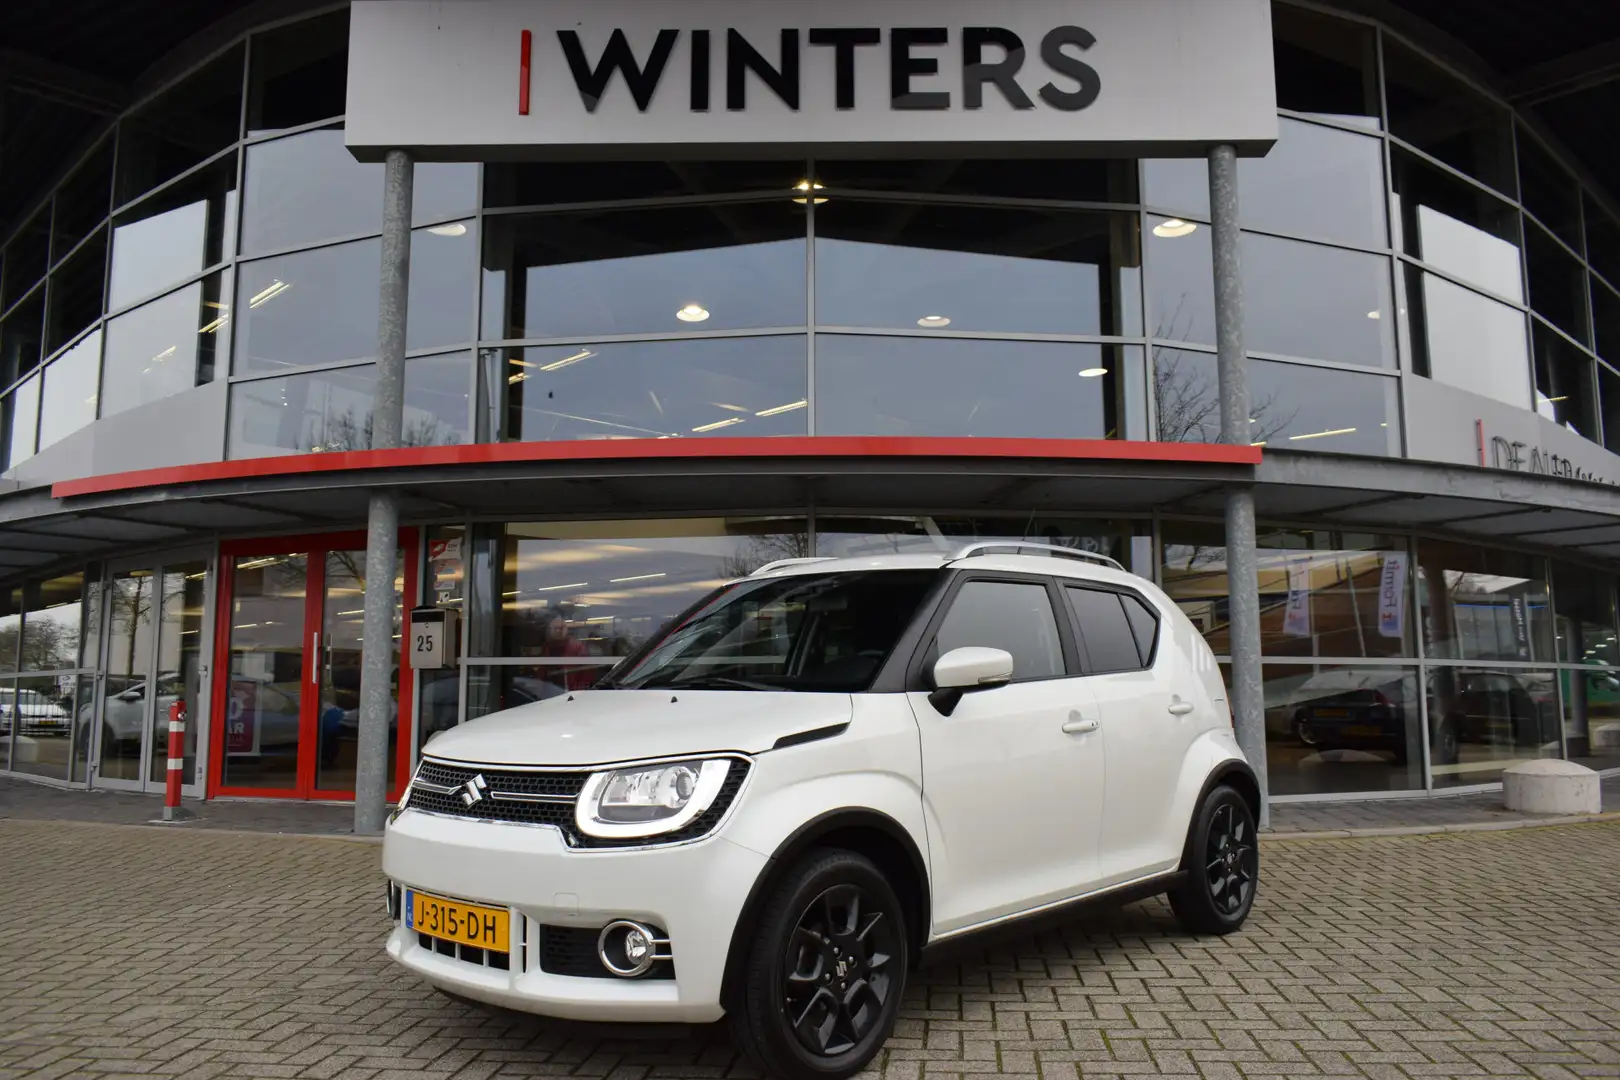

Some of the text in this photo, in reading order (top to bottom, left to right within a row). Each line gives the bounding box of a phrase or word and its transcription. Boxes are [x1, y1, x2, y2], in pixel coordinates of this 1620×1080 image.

[556, 25, 1103, 112] WINTERS
[416, 634, 434, 652] 25
[417, 900, 497, 944] J-315-DH
